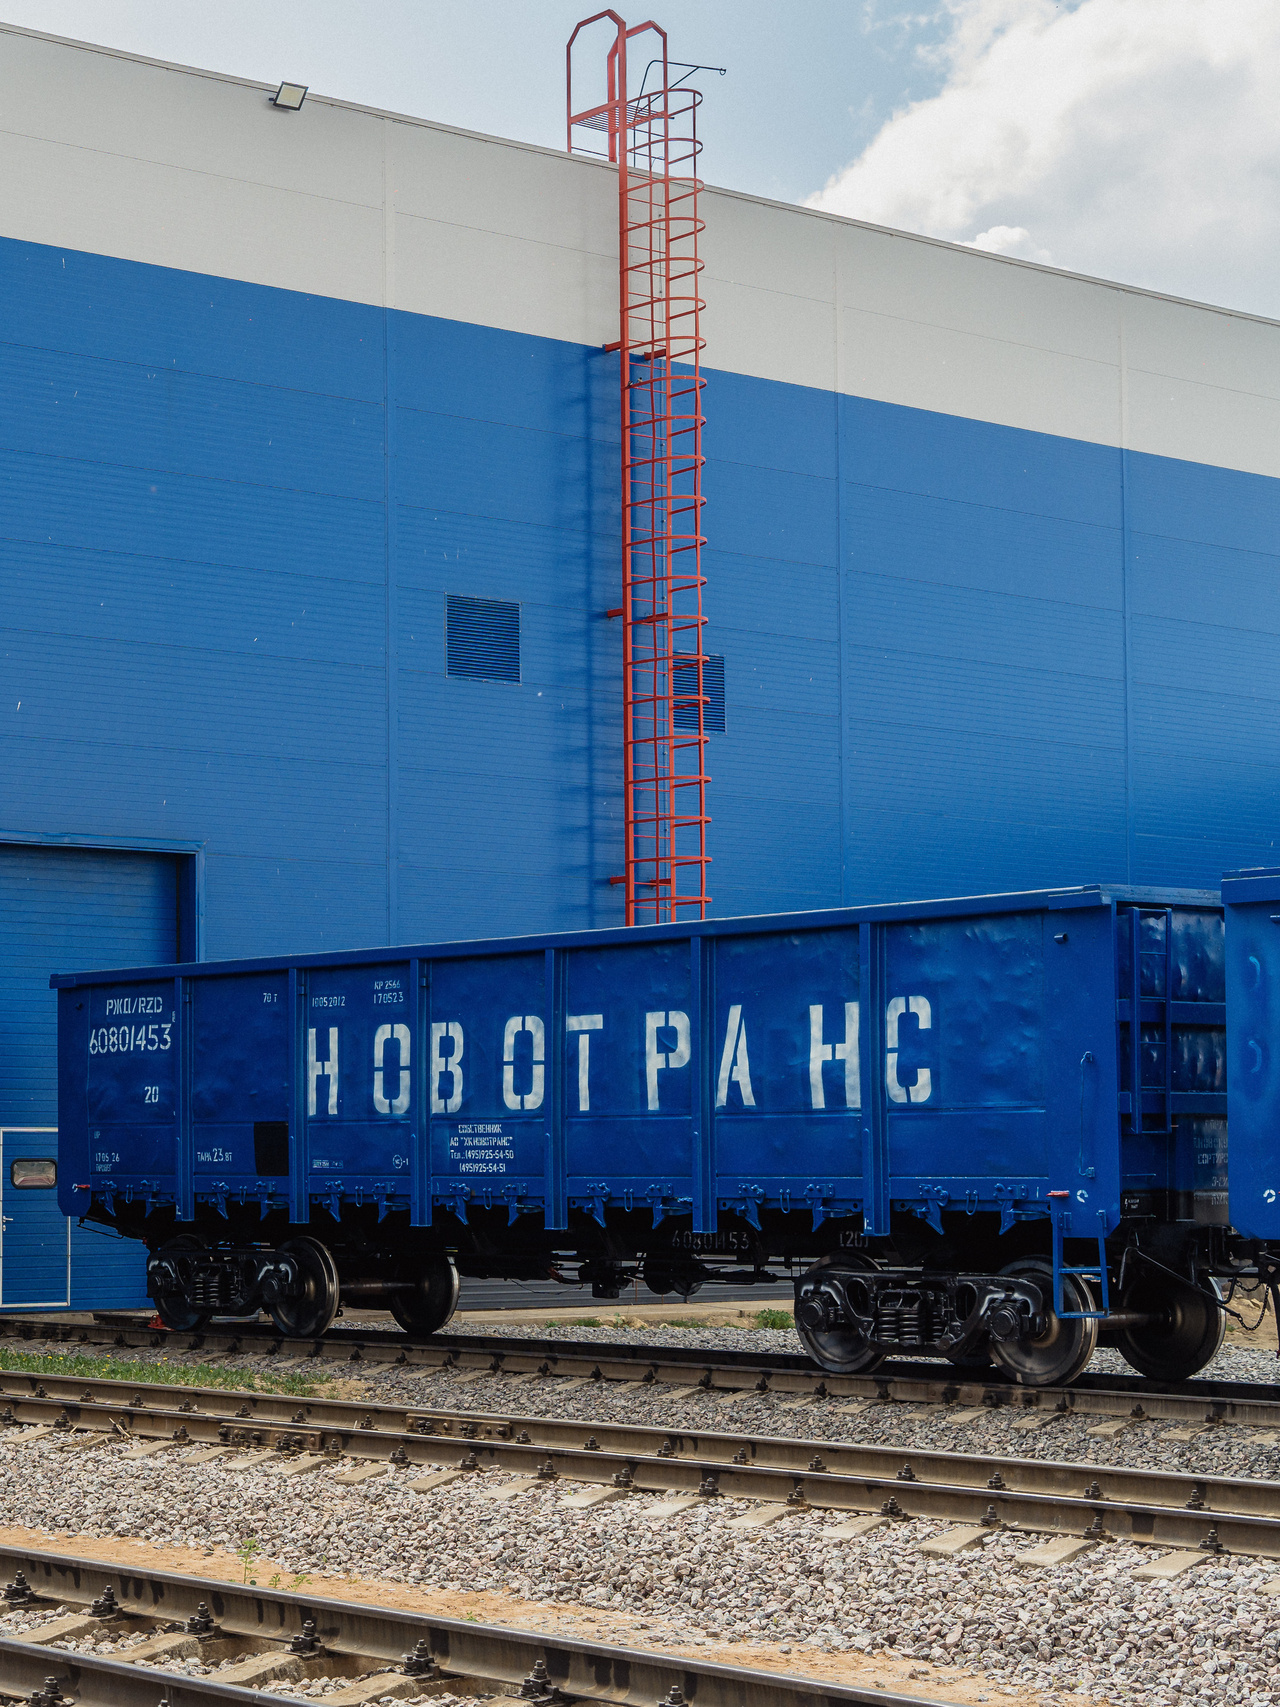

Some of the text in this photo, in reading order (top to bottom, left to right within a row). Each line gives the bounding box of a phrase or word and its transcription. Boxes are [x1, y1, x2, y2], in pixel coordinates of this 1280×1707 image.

[262, 992, 272, 1003] 70
[373, 991, 404, 1004] 170523
[106, 997, 163, 1015] РЖД/RZD
[89, 1023, 172, 1055] 60801453
[307, 996, 933, 1116] НОВОТРАНС
[144, 1086, 160, 1104] 20
[457, 1124, 503, 1134] СОБСТВЕННИК
[459, 1163, 506, 1173] (495)925-54-51
